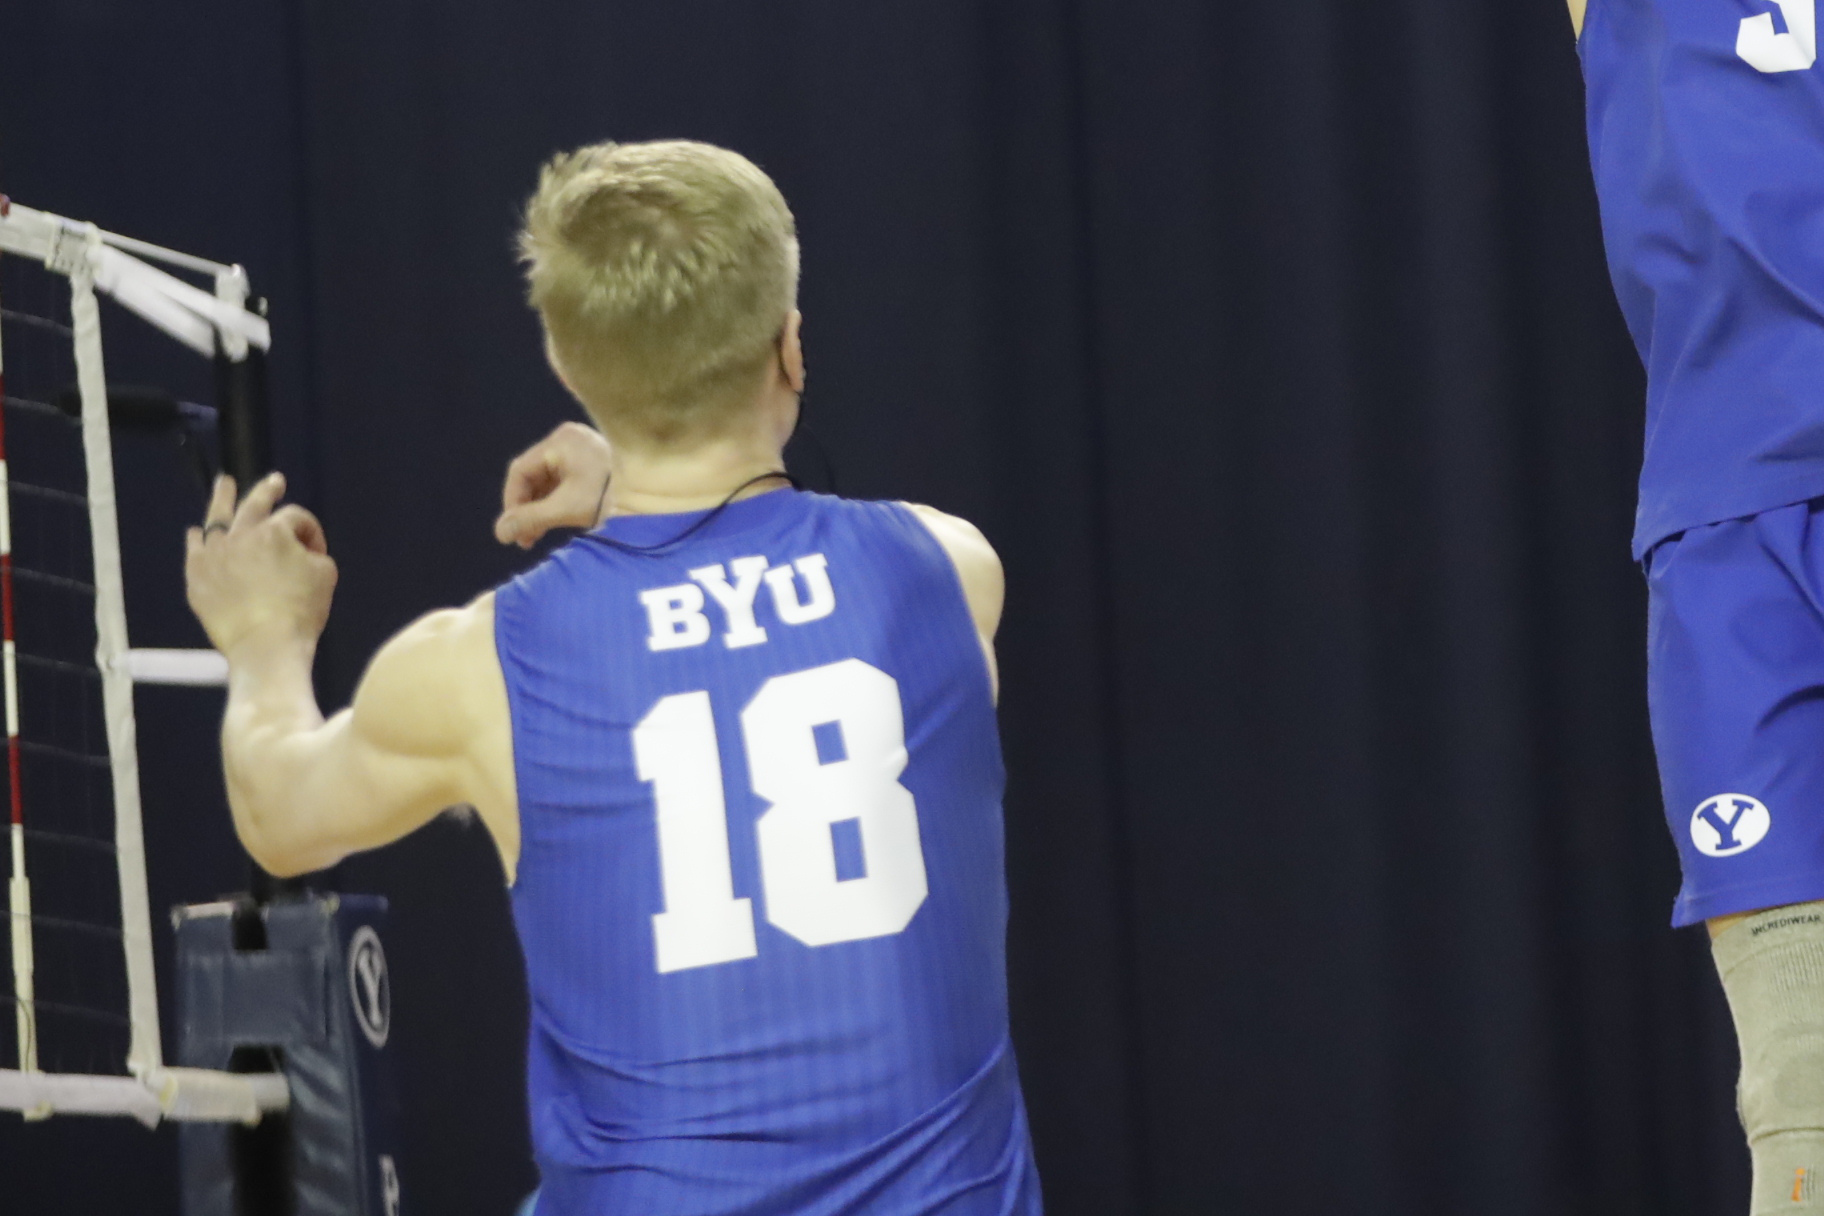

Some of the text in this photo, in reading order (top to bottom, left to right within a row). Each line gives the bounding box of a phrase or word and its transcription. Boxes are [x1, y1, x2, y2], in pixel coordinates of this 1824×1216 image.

[638, 553, 836, 652] BYU
[631, 657, 929, 974] 18
[1697, 799, 1755, 850] Y
